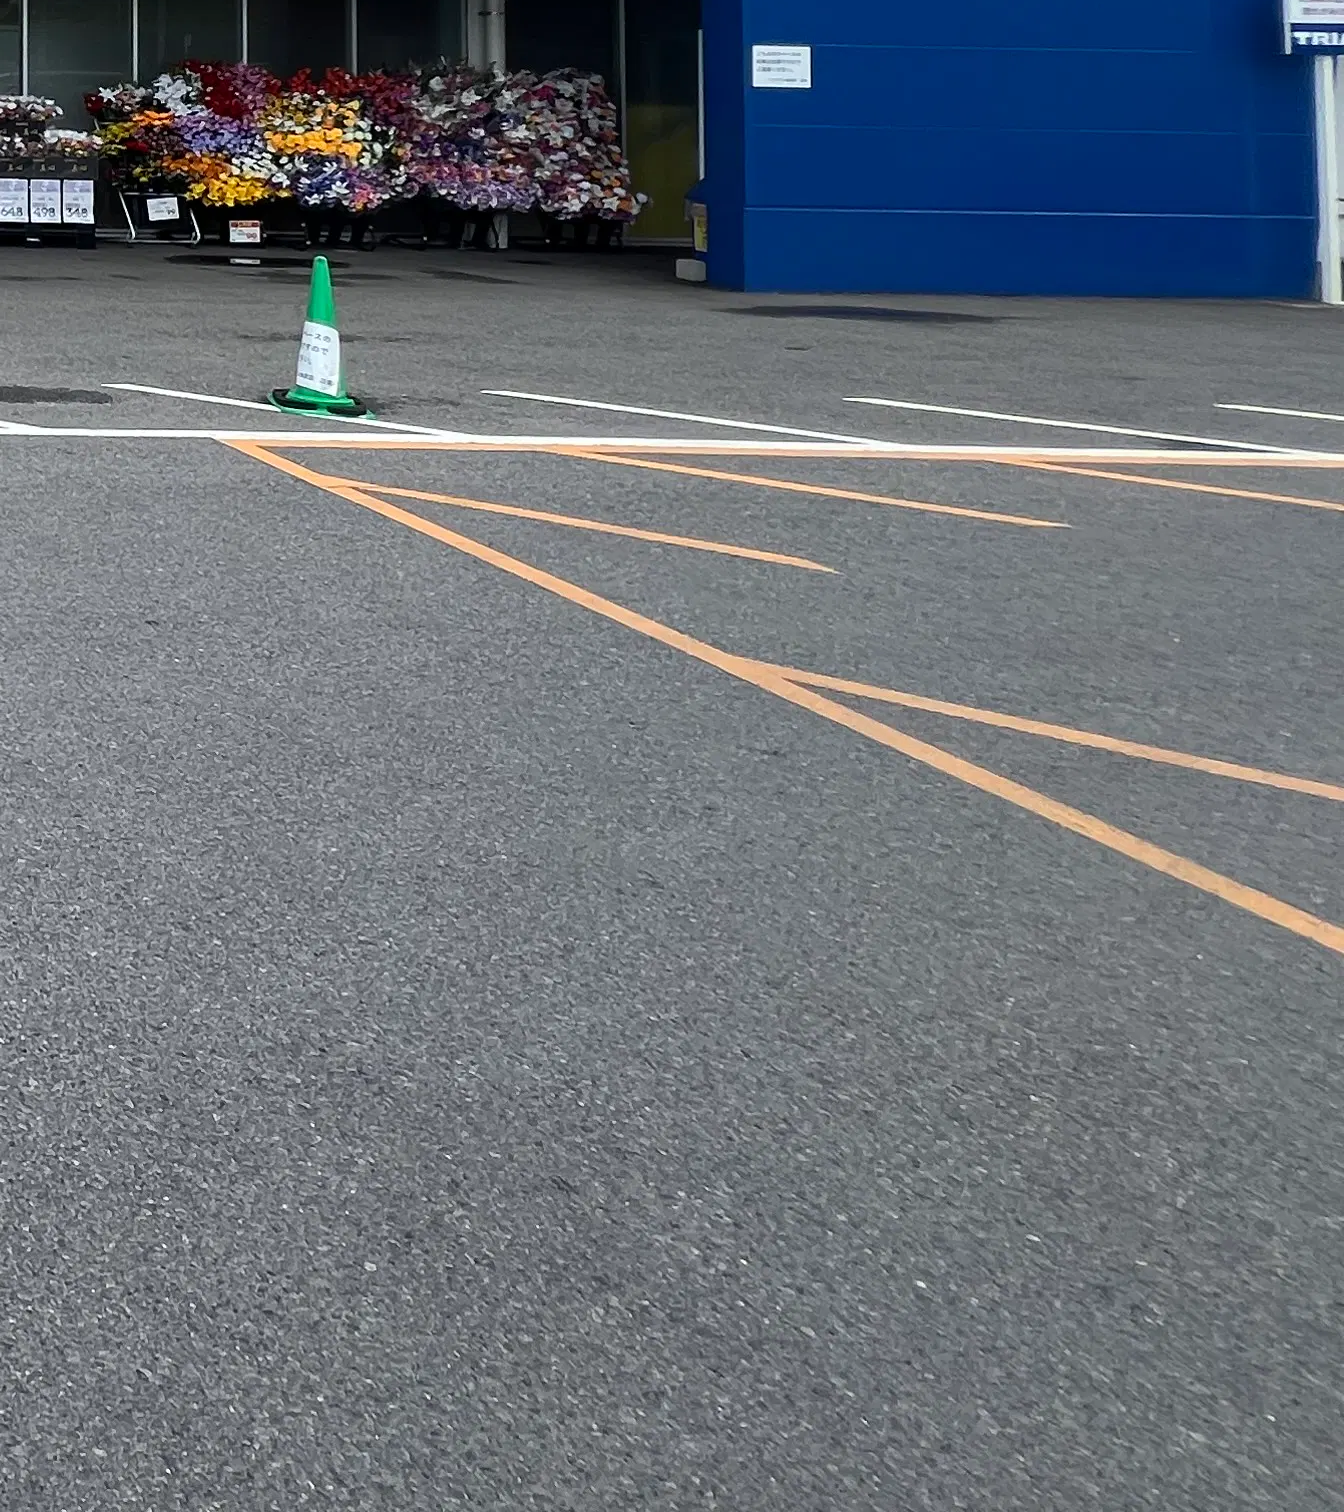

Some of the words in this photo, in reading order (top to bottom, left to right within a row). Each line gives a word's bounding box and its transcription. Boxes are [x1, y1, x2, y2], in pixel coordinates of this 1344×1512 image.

[0, 206, 23, 217] 648
[33, 207, 56, 218] 498
[65, 207, 88, 218] 348
